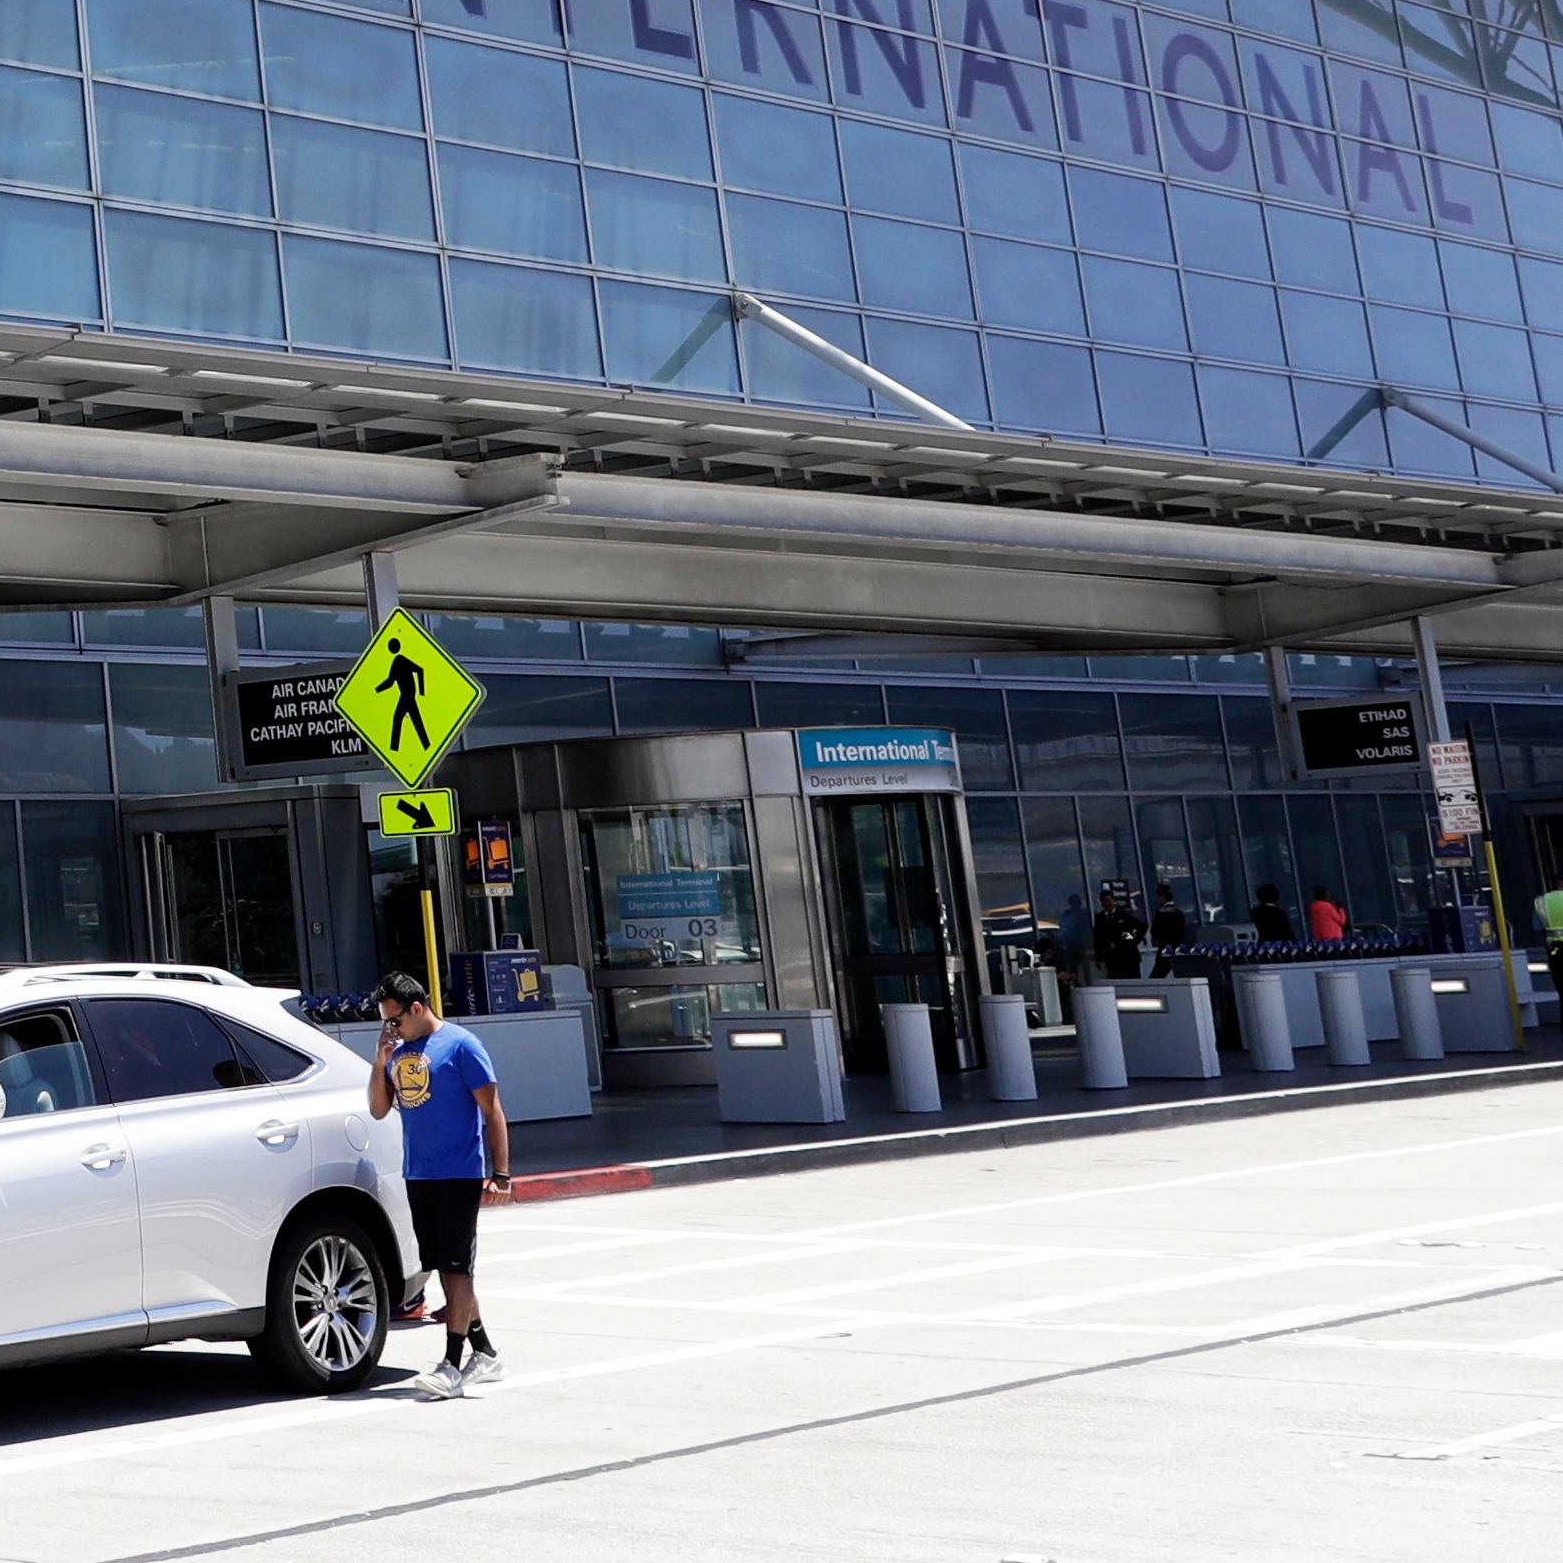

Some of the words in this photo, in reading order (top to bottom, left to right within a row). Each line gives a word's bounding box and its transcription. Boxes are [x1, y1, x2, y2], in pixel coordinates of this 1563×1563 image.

[271, 683, 294, 699] AIR
[297, 676, 345, 696] CANAD
[274, 703, 298, 720] AIR
[300, 699, 338, 716] FRAN
[1358, 708, 1407, 723] ETIHAD
[250, 722, 304, 742] CATHAY
[307, 718, 356, 736] PACIFI
[1382, 725, 1410, 739] SAS
[331, 737, 363, 755] KLM
[815, 738, 930, 763] International
[1355, 744, 1414, 760] VOLARIS
[810, 772, 878, 789] Departures
[882, 772, 908, 786] Level
[620, 879, 673, 889] International
[628, 901, 682, 911] Departures
[684, 899, 710, 908] Level
[625, 924, 667, 939] Door
[688, 918, 718, 937] 03
